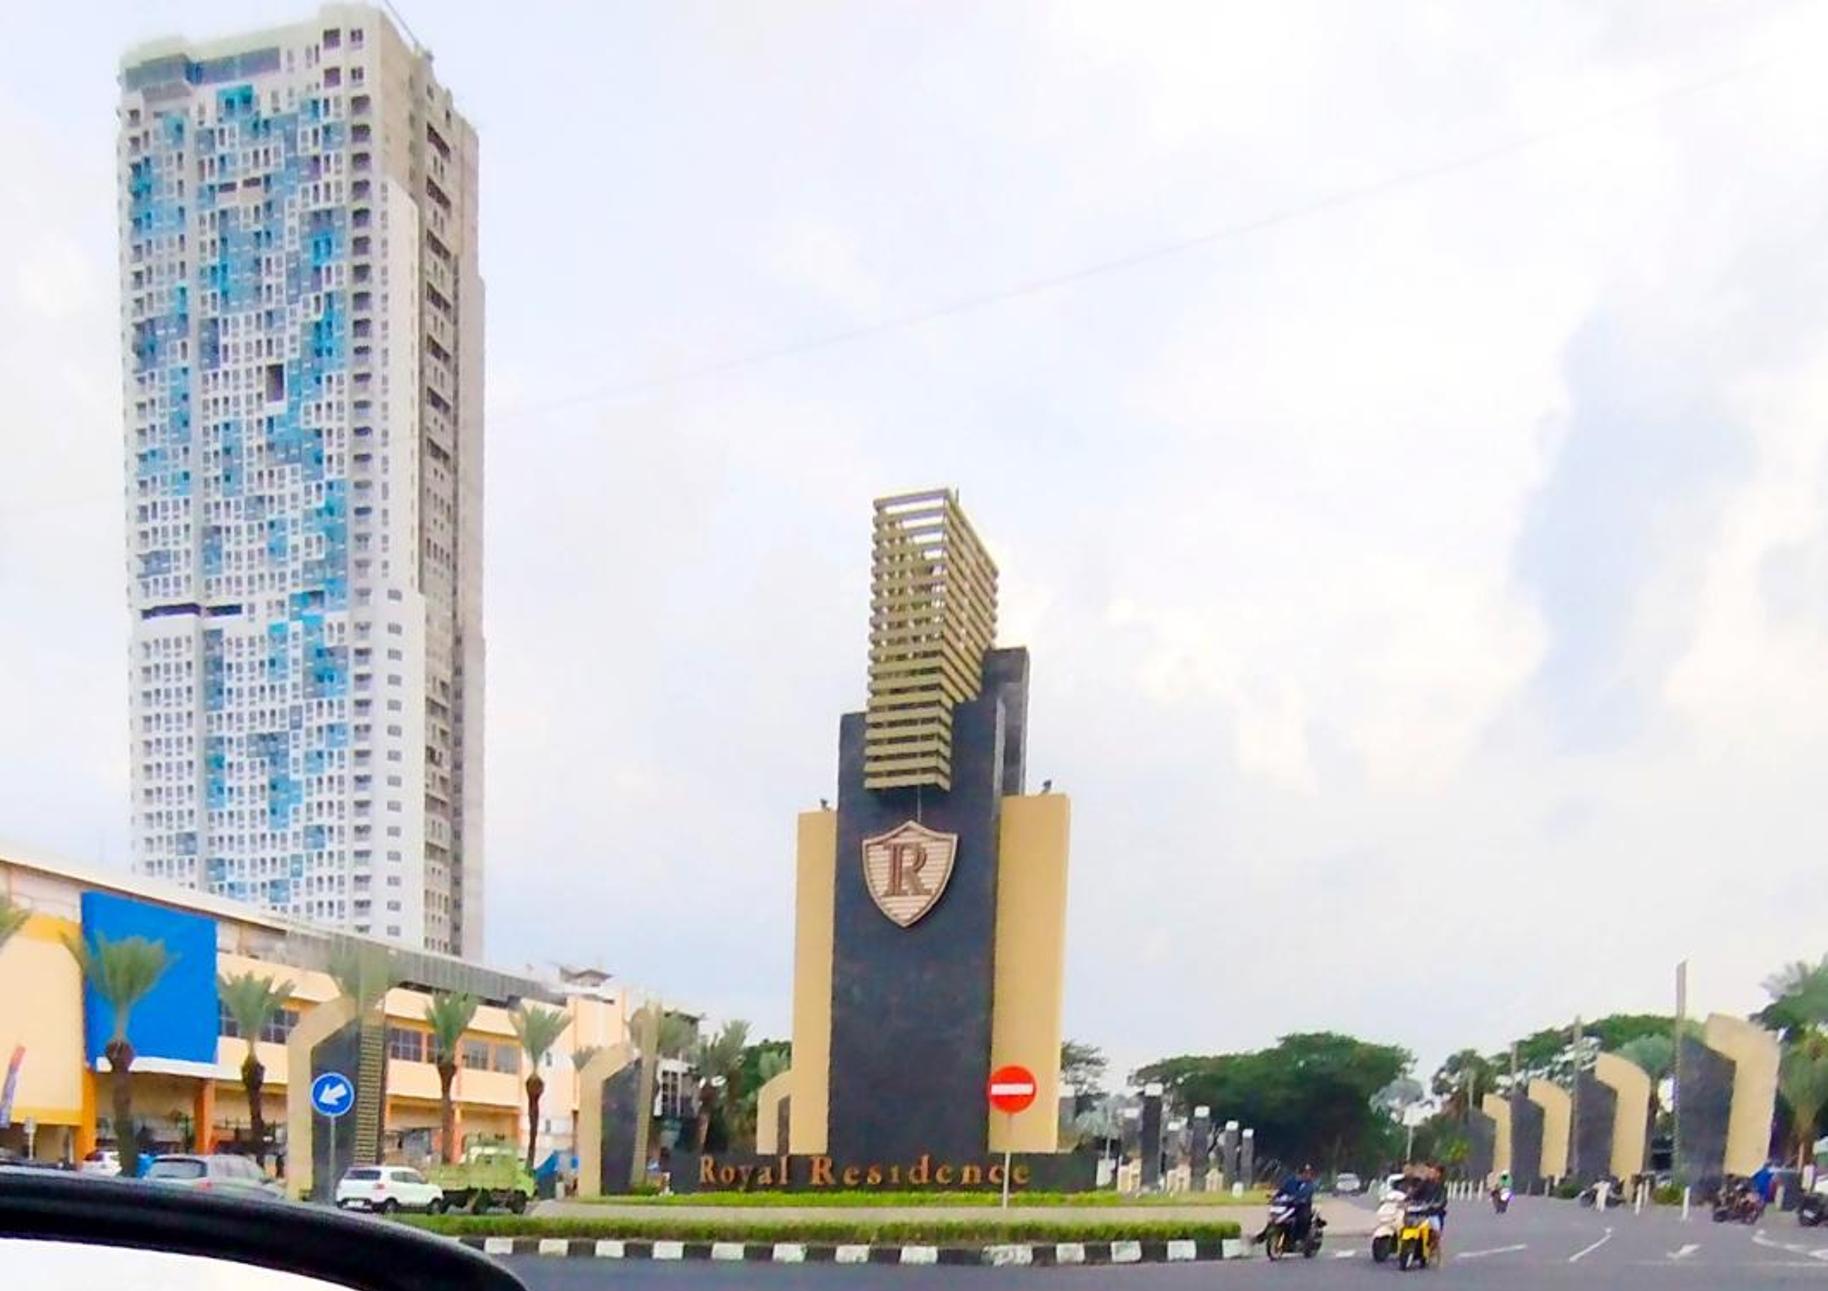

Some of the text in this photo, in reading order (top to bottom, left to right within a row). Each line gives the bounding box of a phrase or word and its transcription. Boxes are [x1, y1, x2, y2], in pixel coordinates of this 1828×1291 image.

[882, 841, 933, 897] R
[699, 1155, 1032, 1191] Royal Residence
